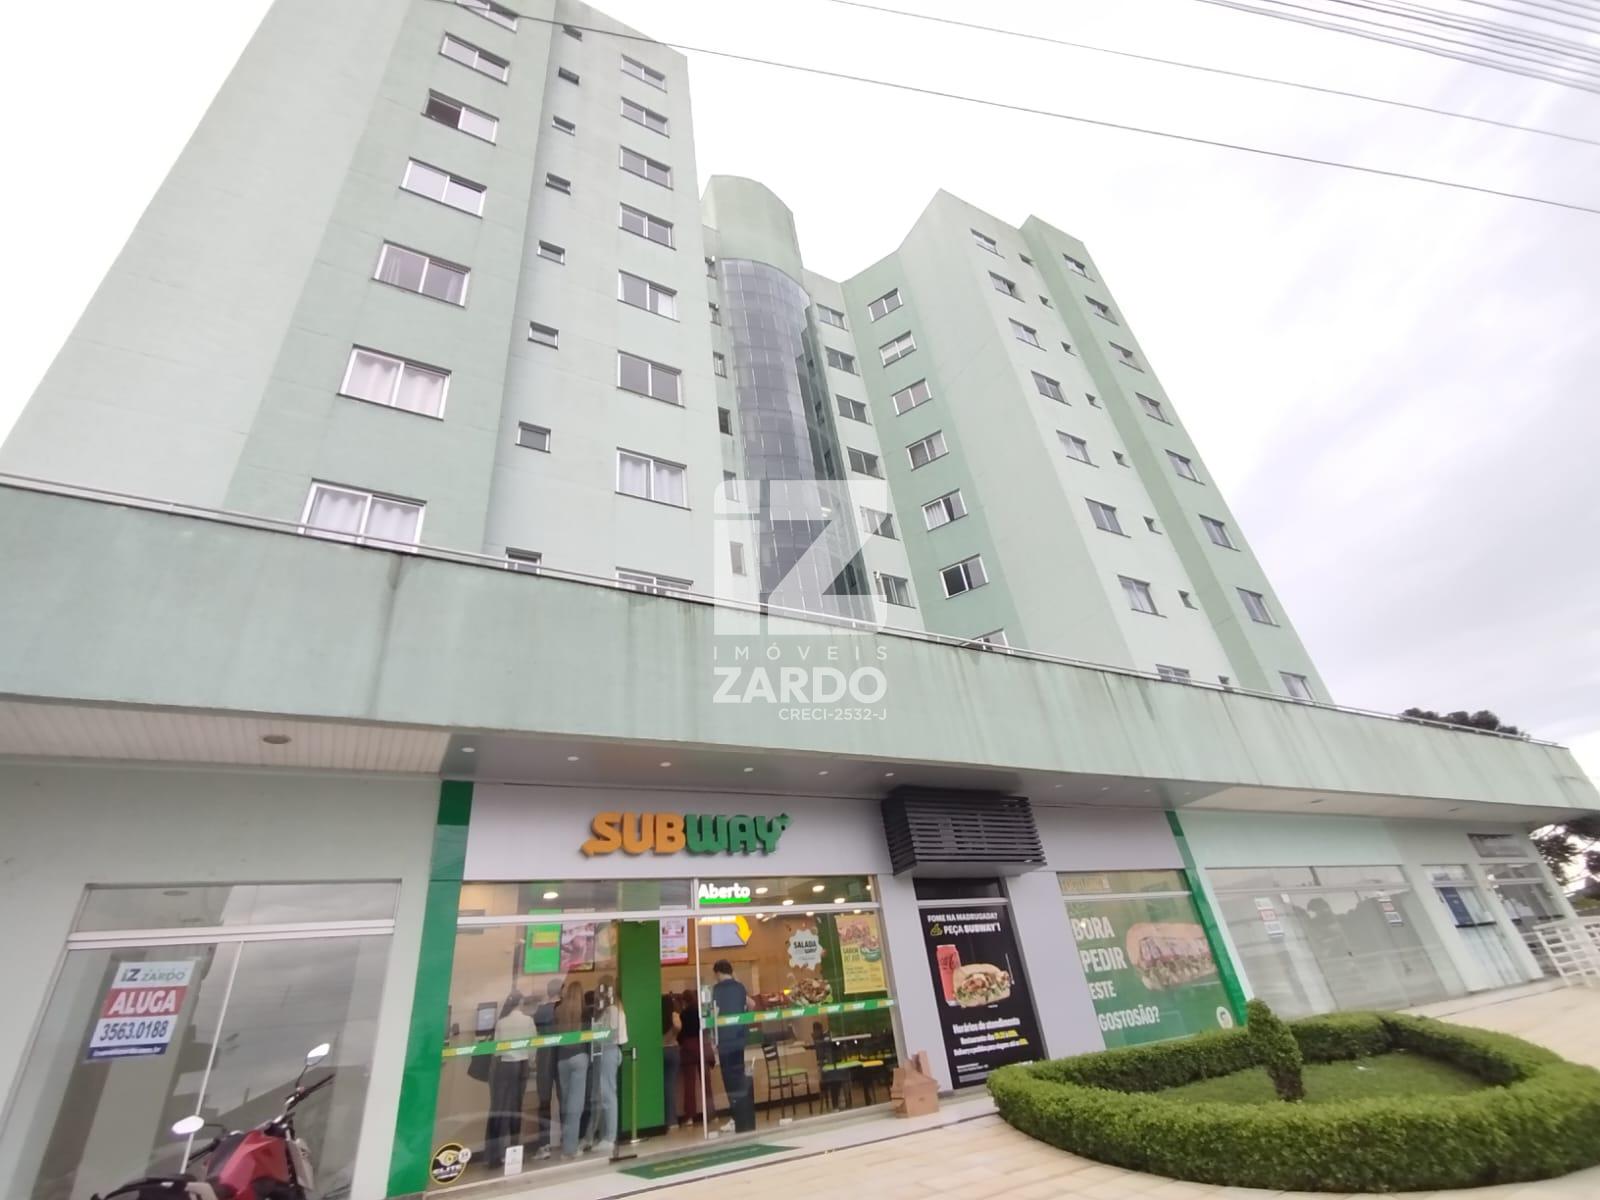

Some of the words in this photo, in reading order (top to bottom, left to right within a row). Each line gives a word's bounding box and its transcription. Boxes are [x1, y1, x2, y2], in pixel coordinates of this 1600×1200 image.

[581, 812, 790, 857] SUBWAY
[699, 882, 750, 899] Aberto
[943, 924, 964, 936] PEÇA
[1071, 916, 1115, 941] BORA
[1080, 946, 1128, 973] PEDIR
[141, 971, 186, 982] ZARDO
[1089, 980, 1116, 999] ESTE
[107, 990, 176, 1015] ALUGA
[1098, 1004, 1160, 1031] GOSTOSÃO?
[100, 1020, 168, 1041] 3563.0188
